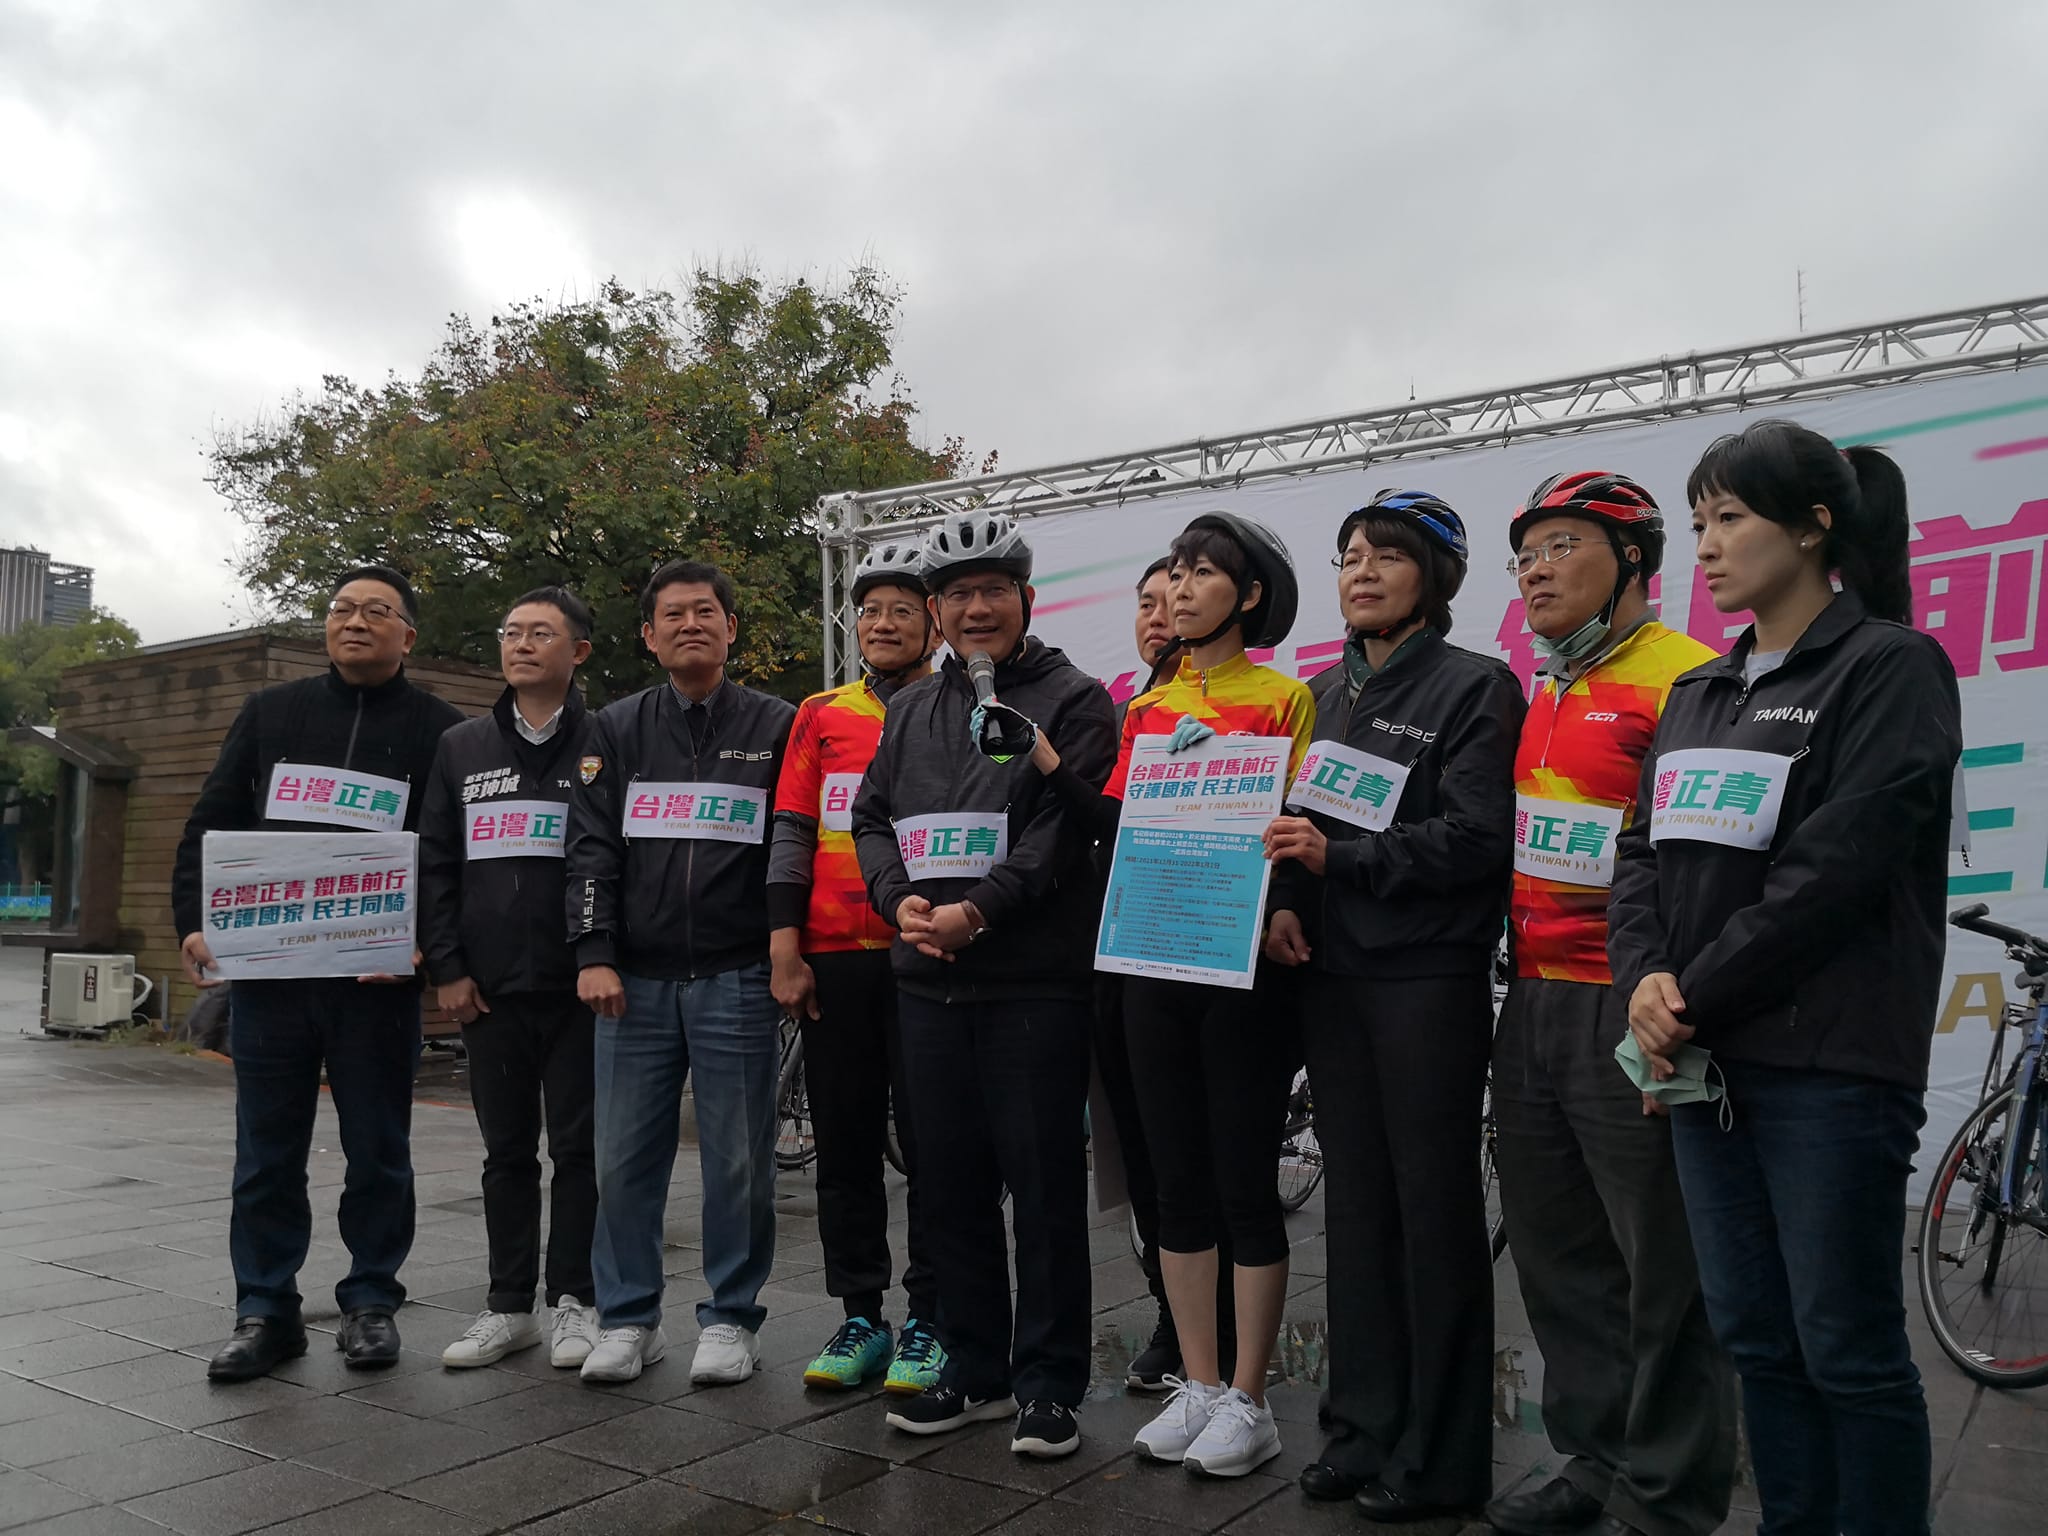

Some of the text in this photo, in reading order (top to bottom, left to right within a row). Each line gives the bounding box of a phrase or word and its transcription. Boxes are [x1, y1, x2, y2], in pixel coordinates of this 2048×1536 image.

[1753, 706, 1818, 724] TAIWAN
[1372, 717, 1437, 743] 2020
[719, 750, 773, 761] 2020
[1131, 755, 1280, 781] 台灣正青 鐵馬前行
[275, 776, 402, 815] 台灣正青
[1128, 775, 1276, 799] 守護國家 民主同騎
[1175, 801, 1249, 812] TEAM TAIWAN
[1307, 788, 1353, 810] TAIWAN
[304, 805, 373, 820] TEAM TAIWAN
[631, 793, 759, 825] 台灣正青
[664, 822, 733, 832] TEAM TAIWAN
[1668, 814, 1718, 826] TAIWAN
[531, 841, 565, 849] TAIWA
[931, 859, 970, 868] TAIWAN
[1528, 853, 1571, 868] TAIWAN
[210, 869, 407, 908] 台灣正青 鐵馬前行
[583, 880, 595, 915] LET'S
[209, 893, 406, 930] 守護國家 民主同騎
[278, 928, 377, 946] TEAM TAIWAN
